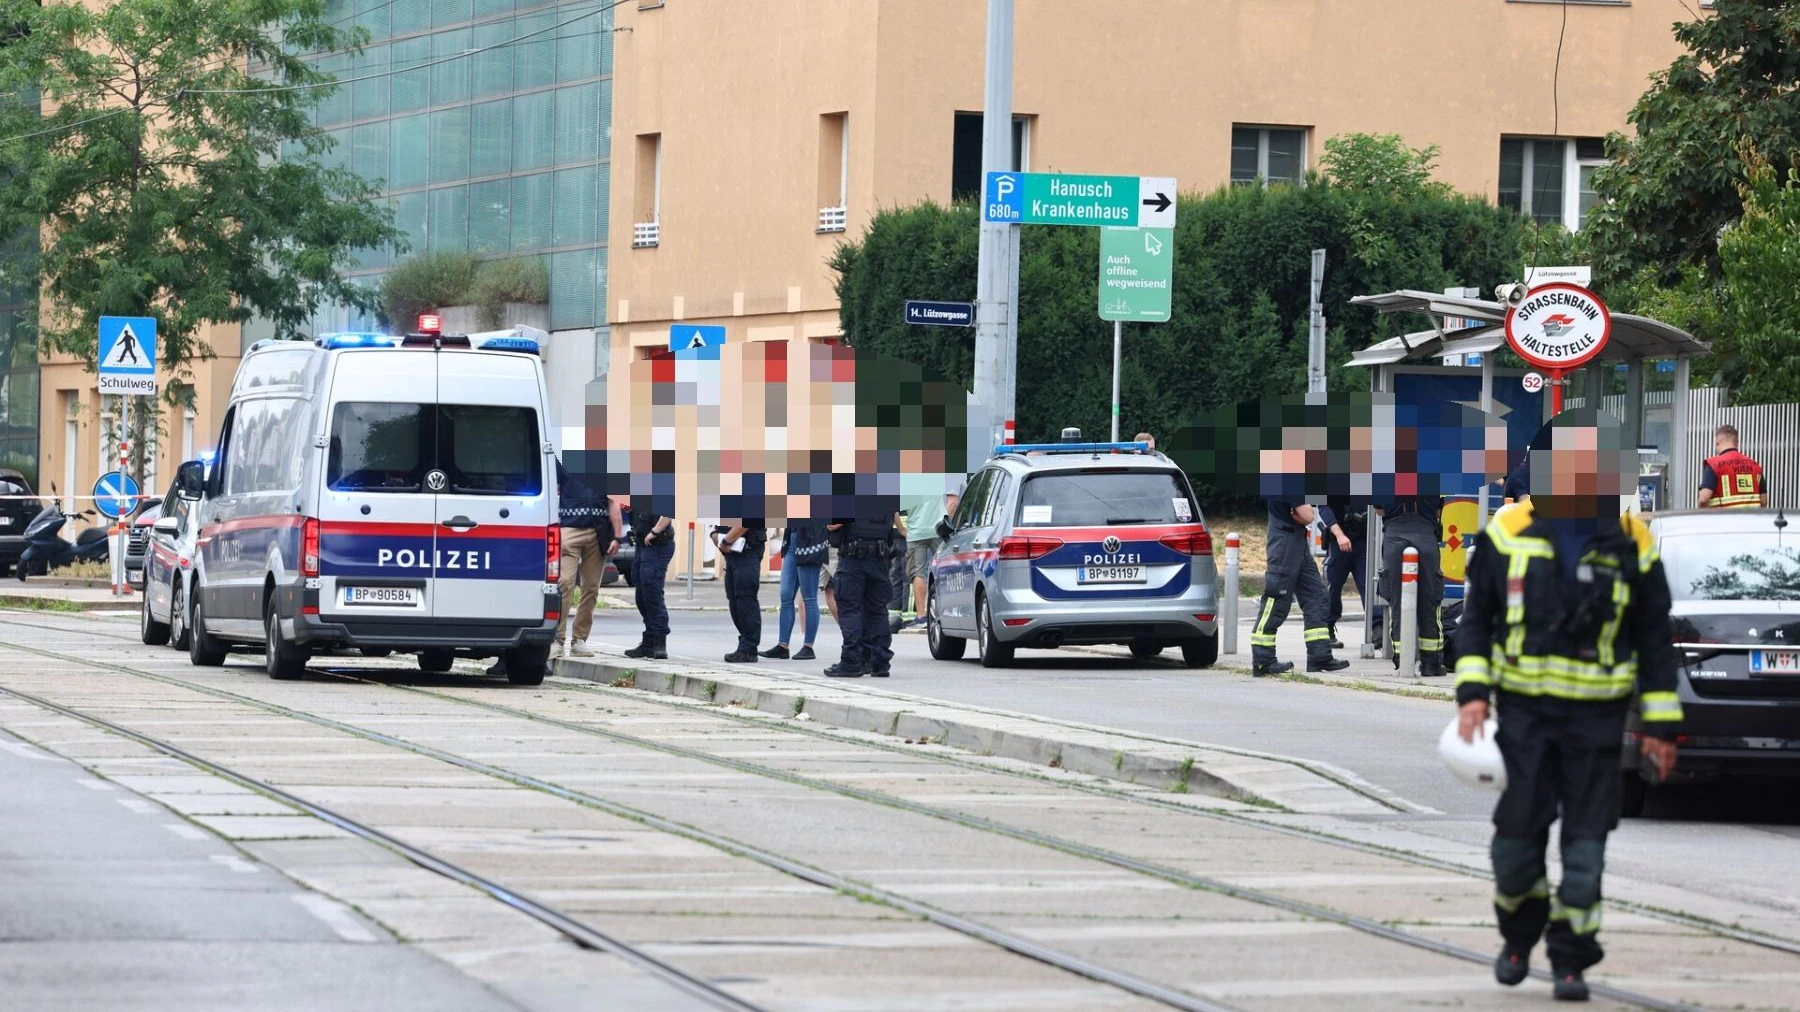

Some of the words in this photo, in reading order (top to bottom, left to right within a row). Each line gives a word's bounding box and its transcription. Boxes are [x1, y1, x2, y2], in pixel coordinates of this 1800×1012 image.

[1050, 179, 1112, 198] Hanusch
[1032, 200, 1129, 219] Krankenhaus
[1106, 255, 1131, 265] Auch
[1106, 266, 1138, 276] offline
[1106, 278, 1167, 290] wegweisend
[1518, 293, 1599, 321] STRASSENBAHN
[923, 308, 968, 321] Lützowgasse
[1521, 333, 1595, 357] HALTESTELLE
[100, 376, 154, 391] Schulweg
[1524, 378, 1541, 388] 52
[1738, 479, 1752, 488] EL
[378, 549, 491, 570] POLIZEI
[1084, 553, 1140, 565] POLIZEI
